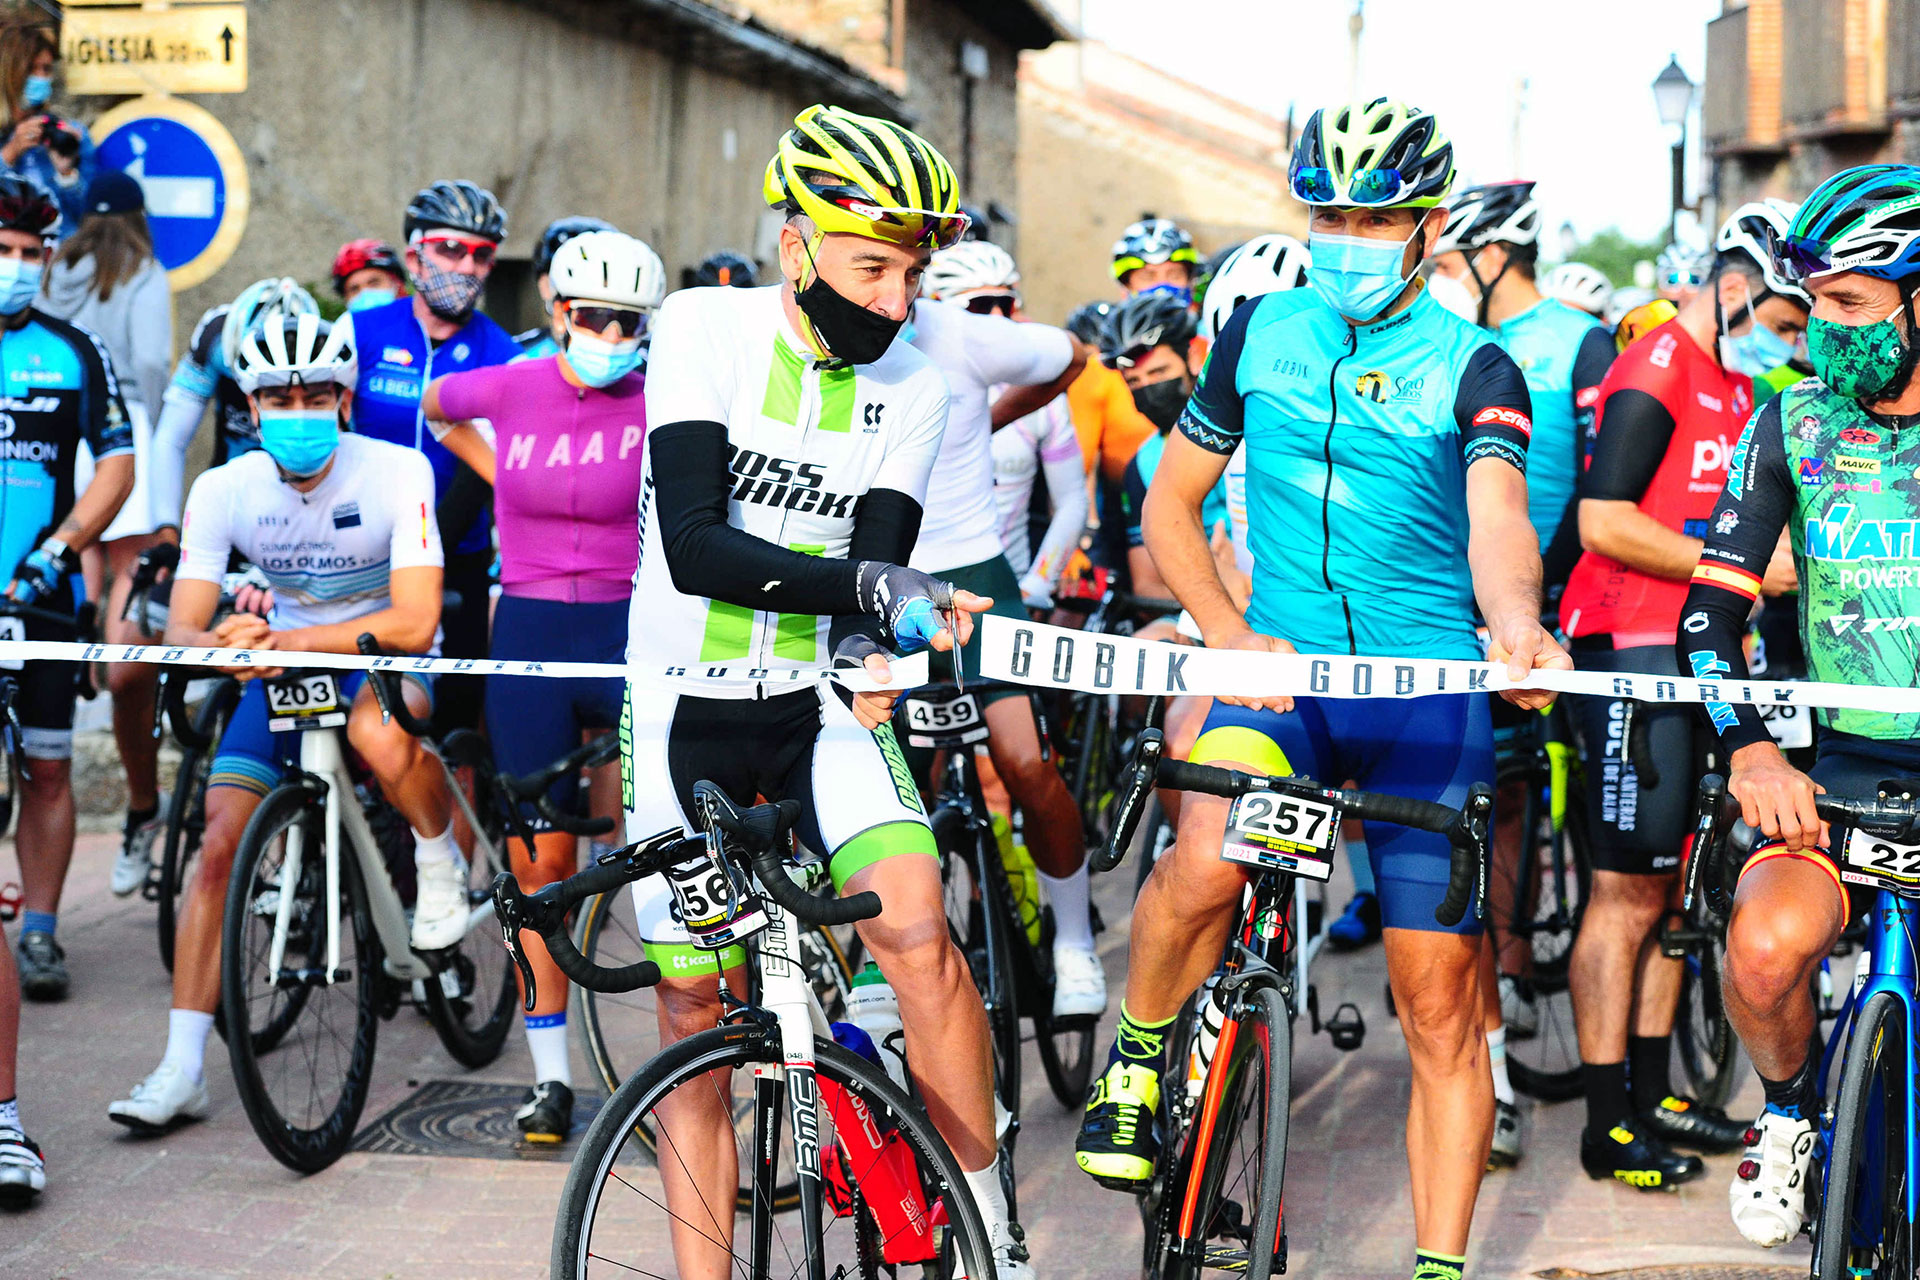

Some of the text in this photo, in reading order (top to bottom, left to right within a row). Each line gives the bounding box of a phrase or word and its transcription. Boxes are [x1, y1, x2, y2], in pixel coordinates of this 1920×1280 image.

[67, 38, 156, 64] IGLESIA
[505, 425, 642, 470] MAAP
[1839, 460, 1877, 470] MAVIC
[262, 558, 293, 569] LOS
[297, 555, 357, 569] OLMOS
[1010, 628, 1189, 692] GOBIK
[1310, 660, 1489, 695] GOBIK
[274, 682, 330, 705] 203
[914, 702, 972, 727] 459
[1242, 797, 1327, 840] 257
[1225, 846, 1251, 860] 2021
[1844, 873, 1870, 884] 2021
[786, 1052, 803, 1060] 048
[788, 1070, 822, 1182] BMC
